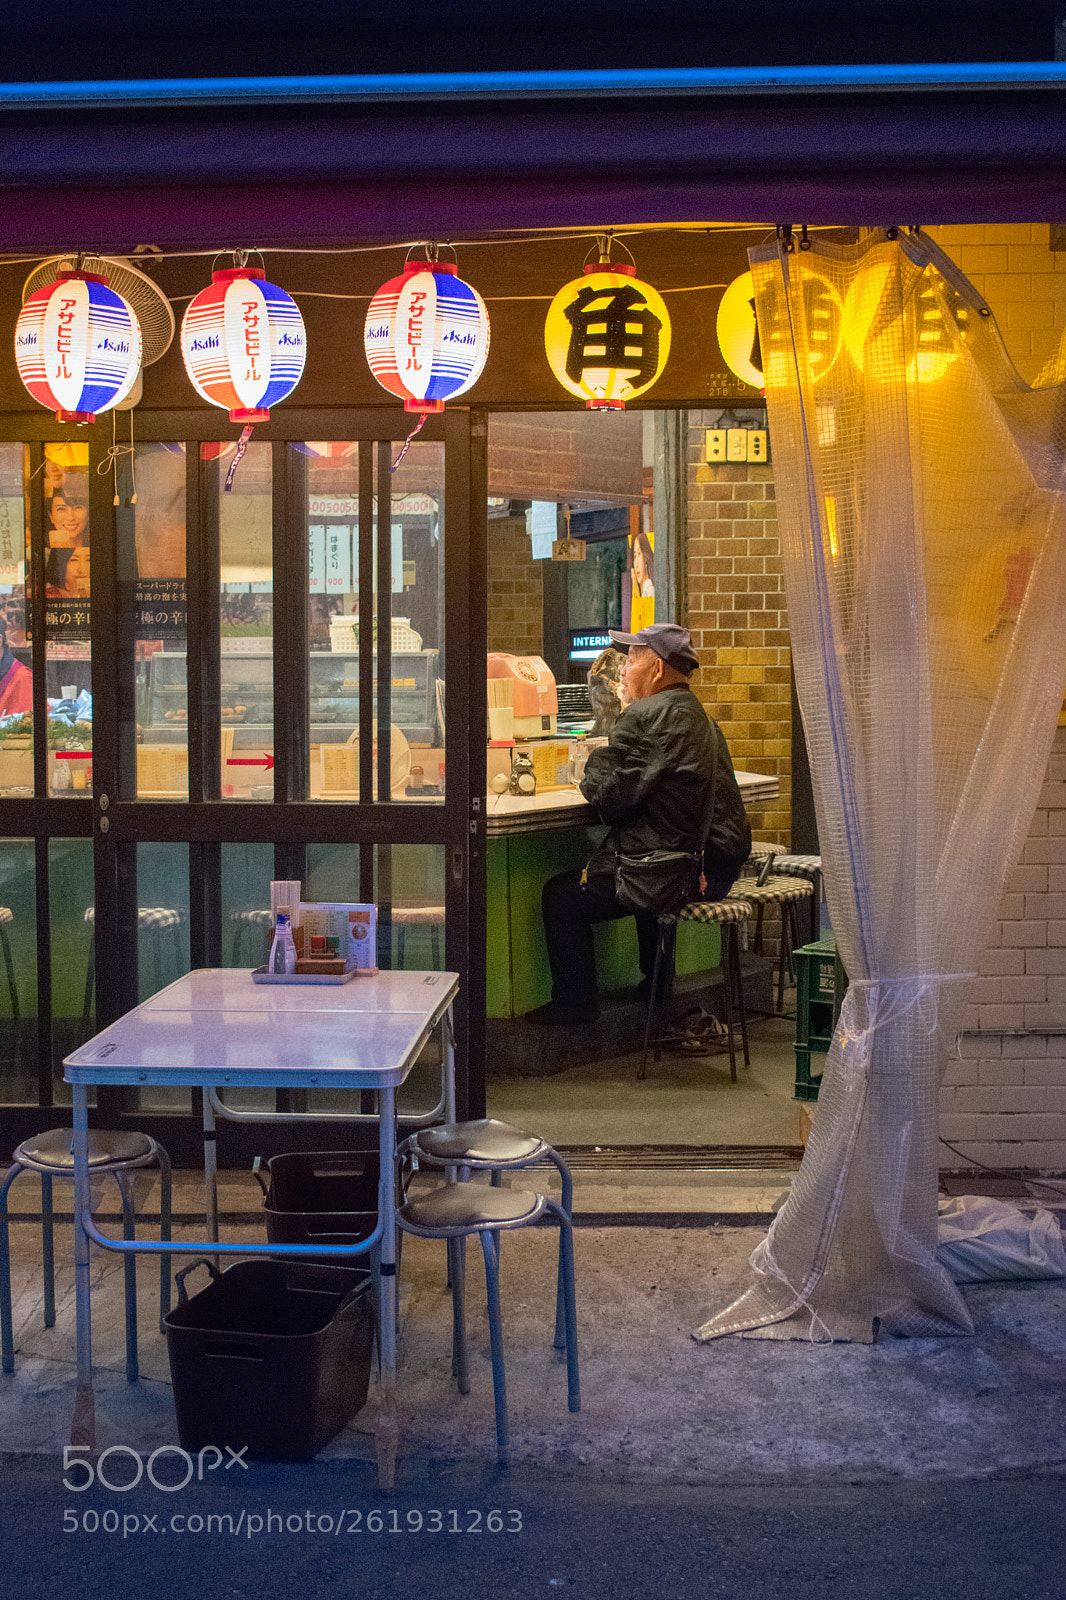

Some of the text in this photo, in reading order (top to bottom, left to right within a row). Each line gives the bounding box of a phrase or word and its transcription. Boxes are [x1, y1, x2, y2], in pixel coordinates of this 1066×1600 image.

[56, 299, 76, 379] アサヒビール
[367, 326, 389, 339] Asahi
[405, 292, 427, 371] アサヒビール
[443, 330, 476, 345] Asahi
[97, 338, 130, 353] Asahi
[190, 335, 219, 351] Asahi
[242, 302, 261, 381] アサヒビール
[278, 333, 303, 346] Asahi
[136, 582, 185, 590] スーパードライ
[136, 611, 187, 624] 極の辛
